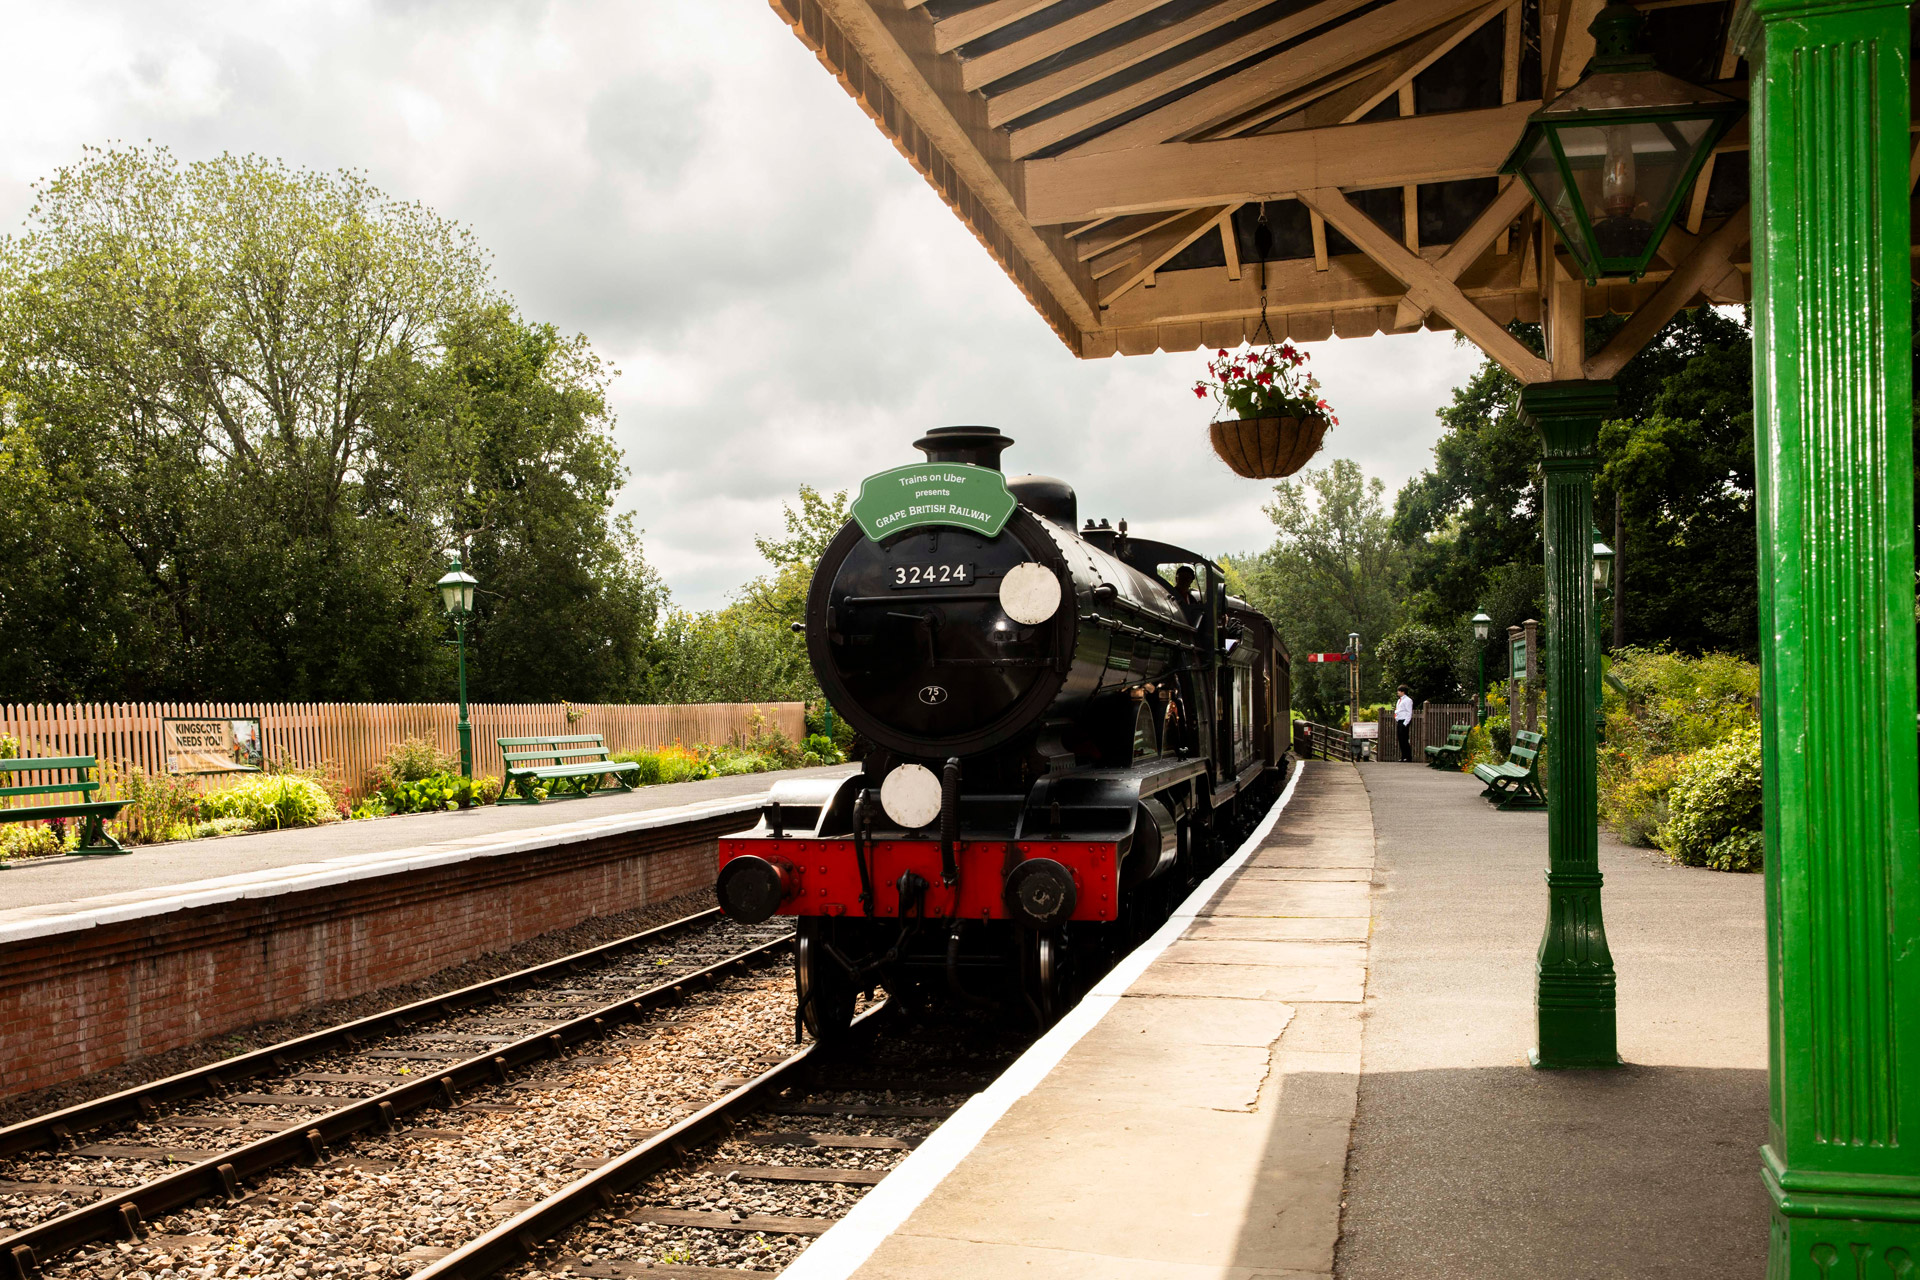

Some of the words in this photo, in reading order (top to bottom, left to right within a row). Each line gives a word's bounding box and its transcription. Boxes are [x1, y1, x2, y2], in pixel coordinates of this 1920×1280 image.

[899, 475, 927, 486] Trains
[943, 473, 966, 483] Uber
[915, 489, 950, 499] presents
[876, 510, 906, 528] GRAPE
[909, 505, 946, 516] BRITISH
[949, 504, 991, 523] RAILWAY
[895, 564, 966, 584] 32424
[927, 687, 939, 695] 75
[175, 723, 222, 734] KINGSCOTE
[176, 736, 202, 747] NEEDS
[204, 736, 223, 746] YOU!
